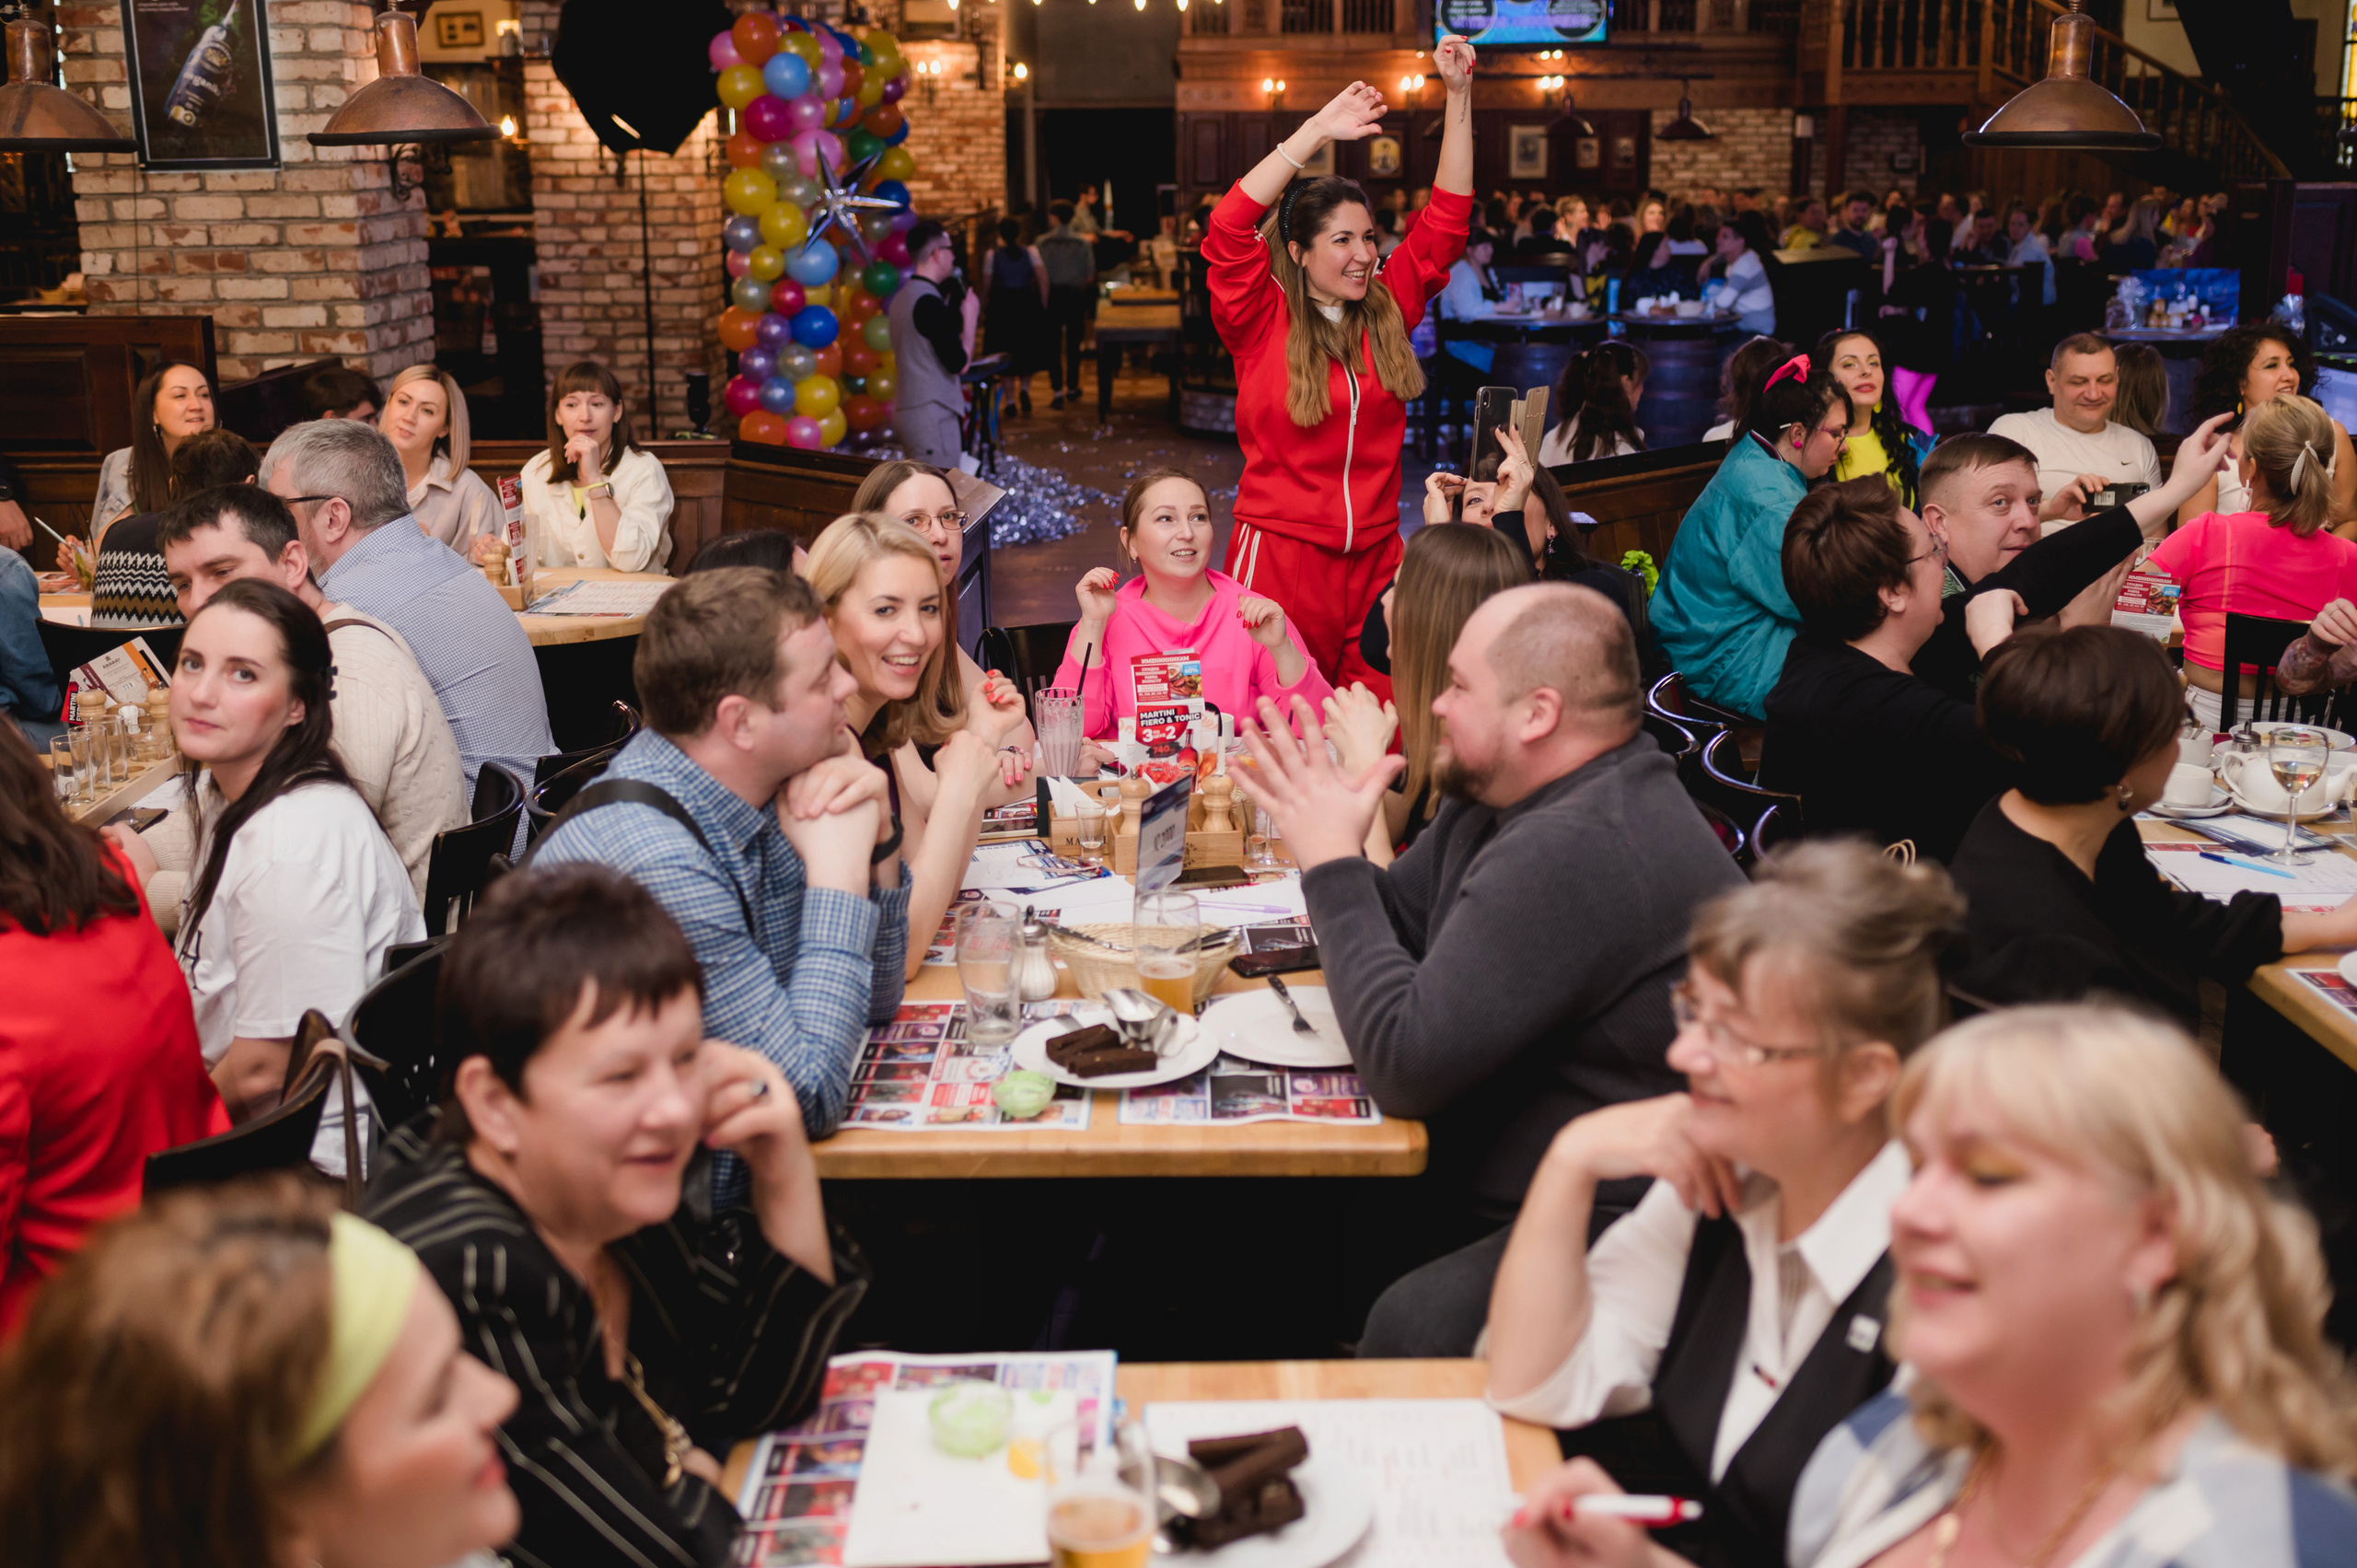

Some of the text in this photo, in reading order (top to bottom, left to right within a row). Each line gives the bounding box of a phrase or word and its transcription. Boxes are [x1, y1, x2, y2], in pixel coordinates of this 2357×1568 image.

[1140, 708, 1175, 719] MARTINI
[1141, 717, 1166, 727] FIERO
[1174, 713, 1201, 723] TONIC
[1143, 728, 1154, 743] 3
[1165, 726, 1177, 739] 2
